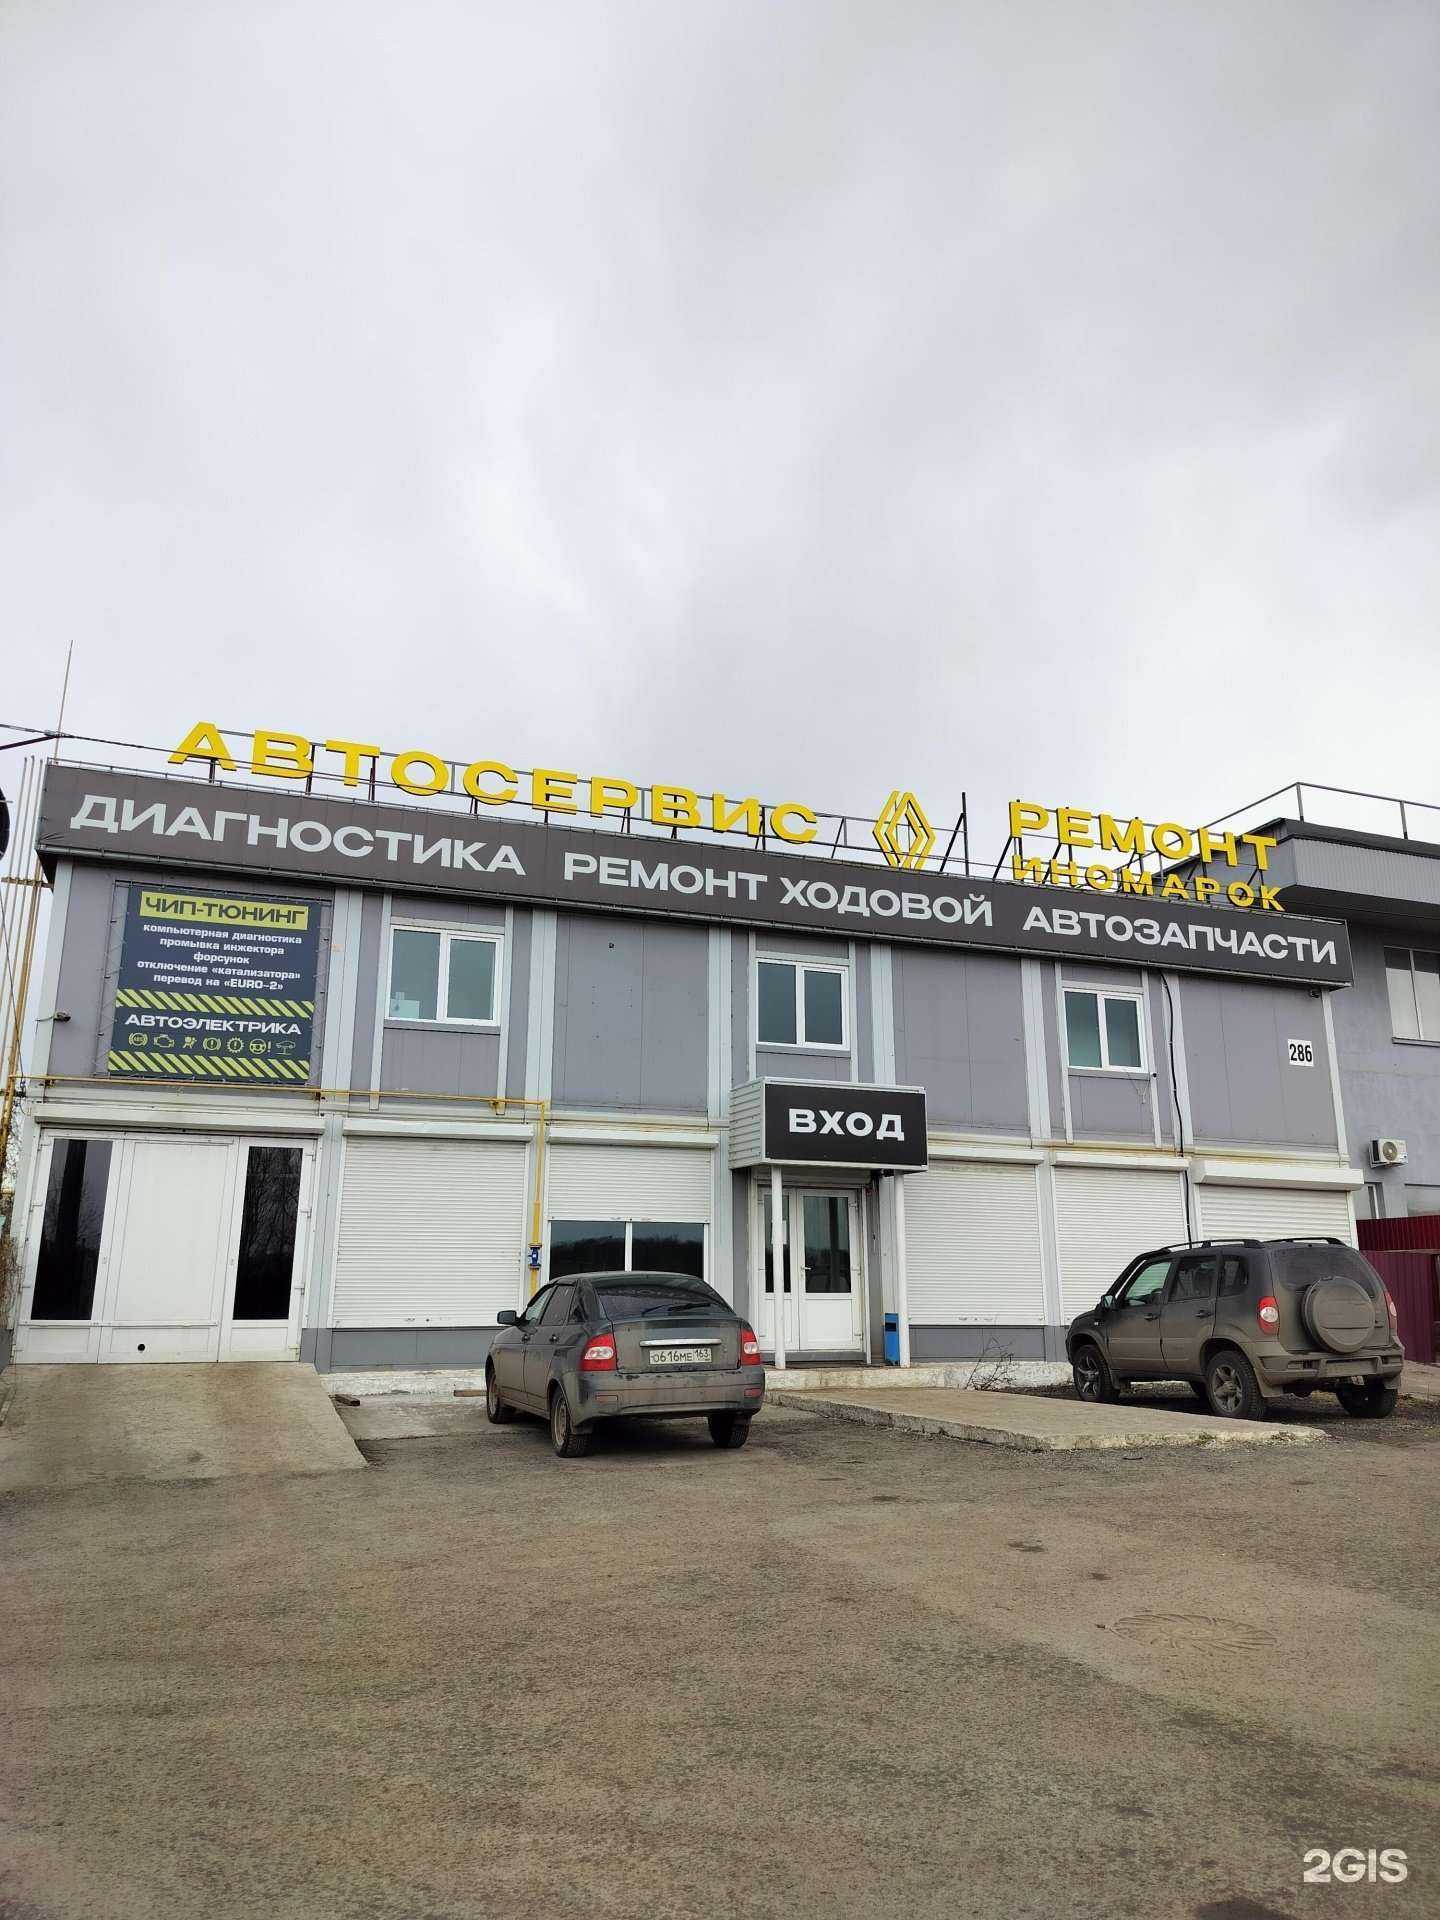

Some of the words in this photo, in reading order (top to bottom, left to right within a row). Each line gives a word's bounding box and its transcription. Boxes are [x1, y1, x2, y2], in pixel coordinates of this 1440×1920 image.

[168, 721, 818, 844] АВТОСЕРВИС
[69, 794, 527, 876] ДИАГНОСТИКА
[1009, 800, 1277, 871] РЕМОНТ
[563, 852, 768, 901] РЕМОНТ
[779, 876, 993, 927] ХОДОВОЙ
[1012, 853, 1285, 912] ИНОМАРОК
[145, 896, 305, 924] ЧИП-ТЮНИНГ
[143, 924, 229, 939] компьютерная
[231, 931, 302, 944] диагностика
[1022, 906, 1337, 965] АВТОЗАПЧАСТИ
[159, 937, 220, 952] промывка
[223, 943, 285, 957] инжектора
[193, 952, 250, 966] форсунок
[136, 961, 208, 974] отключение
[153, 974, 202, 988] перевод
[205, 978, 220, 987] на
[124, 1014, 302, 1035] АВТОЭЛЕКТРИКА
[1289, 1043, 1313, 1063] 286
[788, 1108, 905, 1142] ВХОД
[694, 1349, 709, 1358] 163
